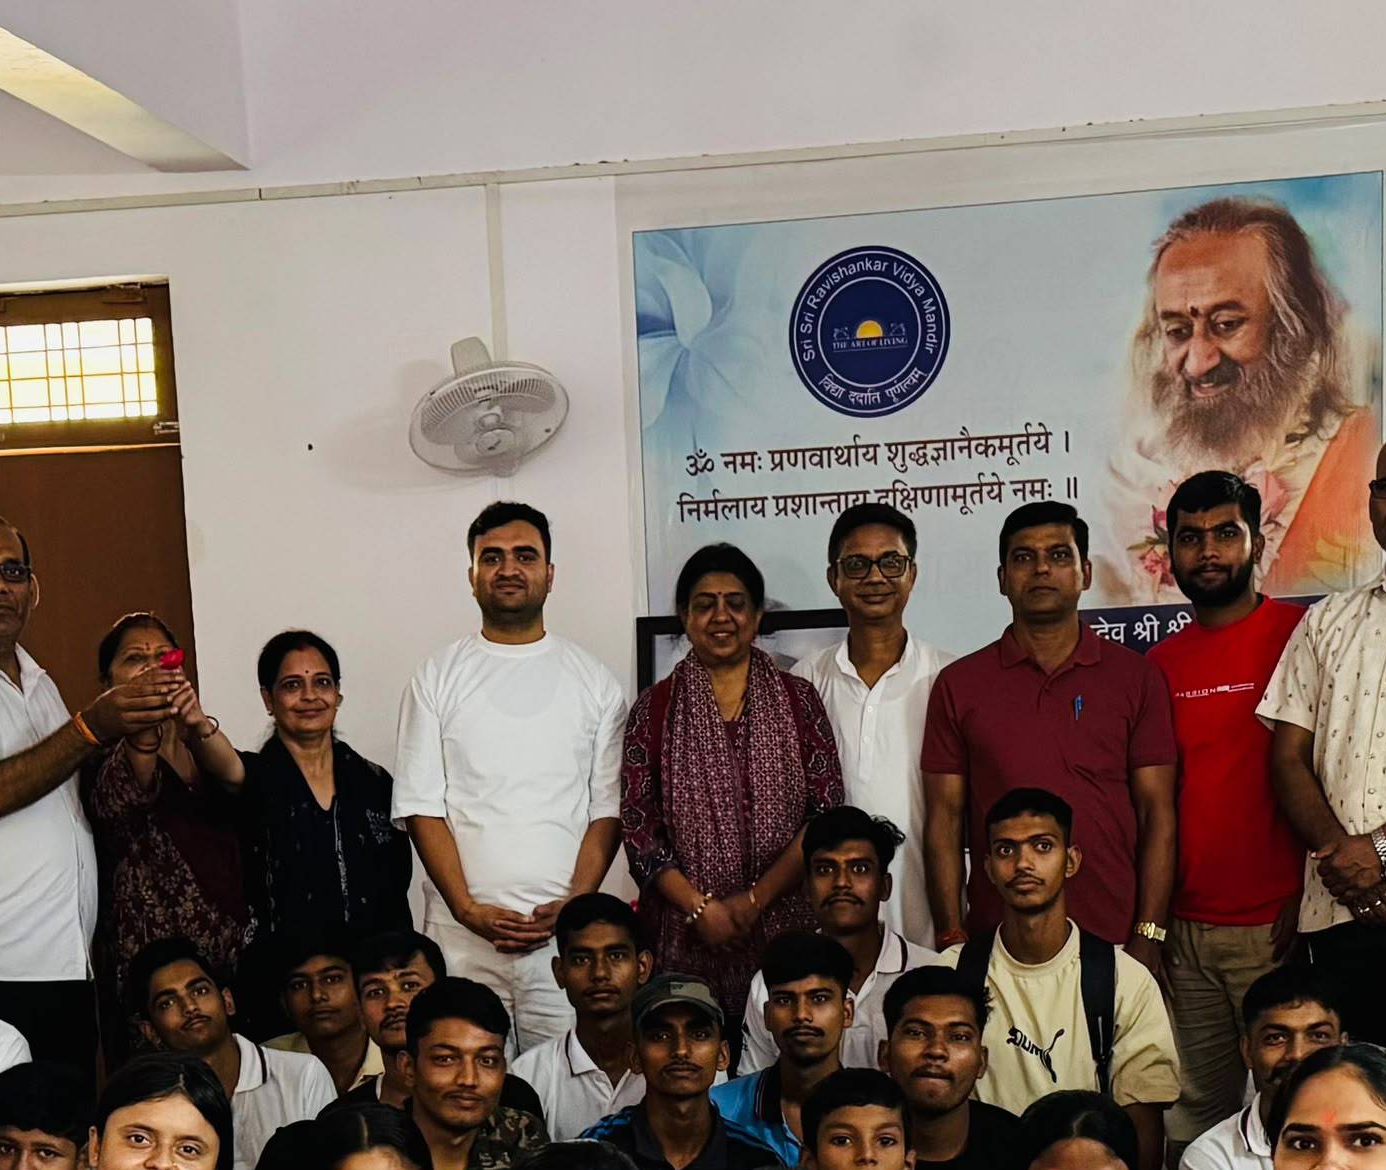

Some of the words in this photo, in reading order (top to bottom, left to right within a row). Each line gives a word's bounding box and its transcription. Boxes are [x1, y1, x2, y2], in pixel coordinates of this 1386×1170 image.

[806, 256, 889, 309] Ravishankar
[893, 262, 926, 297] Vidya
[800, 311, 815, 335] Sri
[922, 298, 938, 354] Mandir
[800, 339, 816, 362] Sri
[685, 448, 715, 477] ॐ
[720, 451, 762, 474] नमः
[767, 434, 881, 472] प्रणवार्थाय
[677, 488, 768, 522] निर्मलाय
[1010, 478, 1052, 502] नमः
[1133, 613, 1161, 642] श्री
